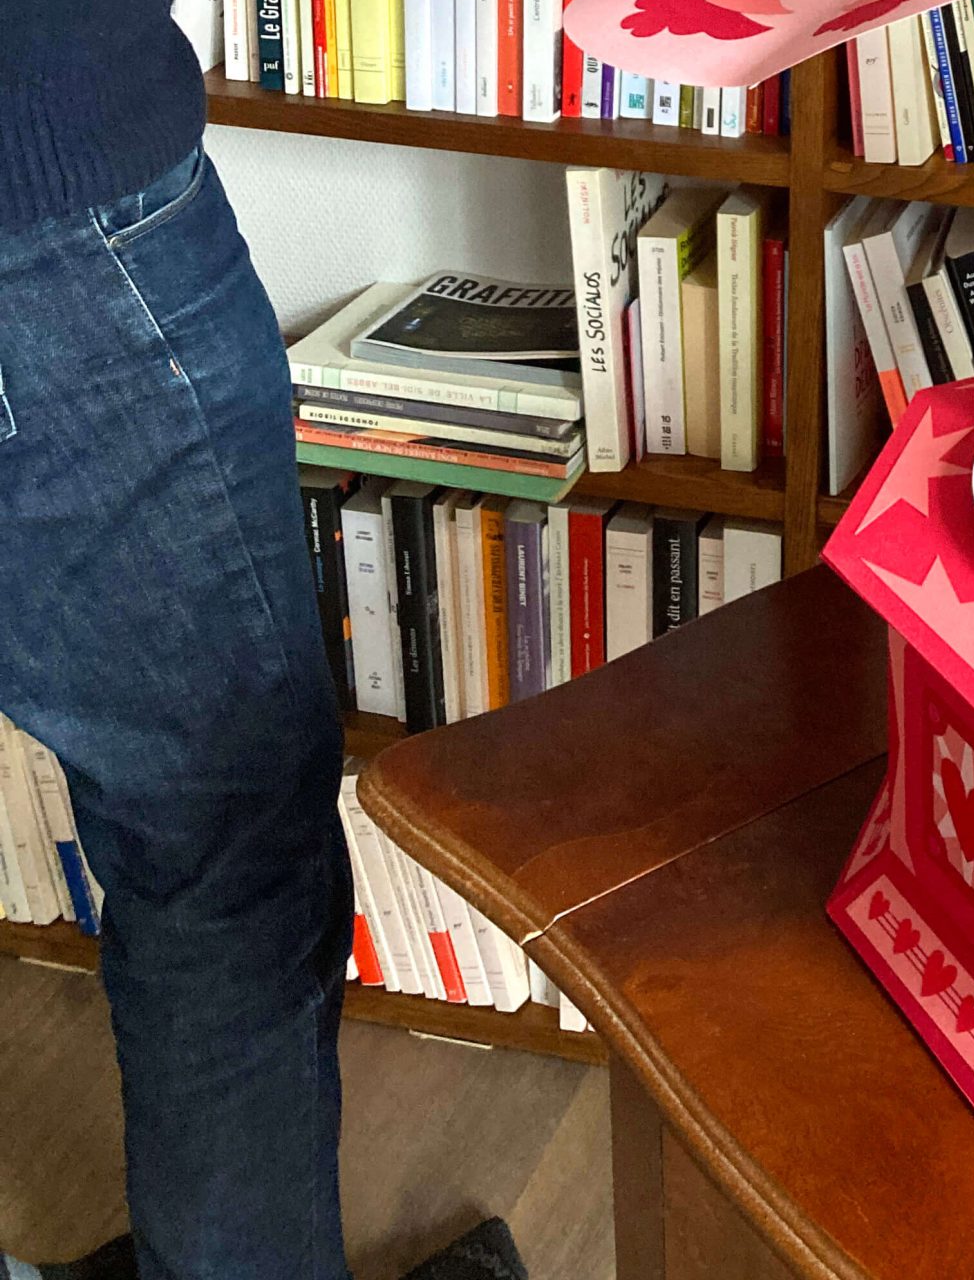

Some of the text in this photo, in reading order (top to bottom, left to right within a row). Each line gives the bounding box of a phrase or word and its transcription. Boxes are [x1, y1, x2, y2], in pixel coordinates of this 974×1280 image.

[260, 24, 281, 39] Le
[590, 347, 607, 372] LES
[667, 539, 683, 621] dit en passant
